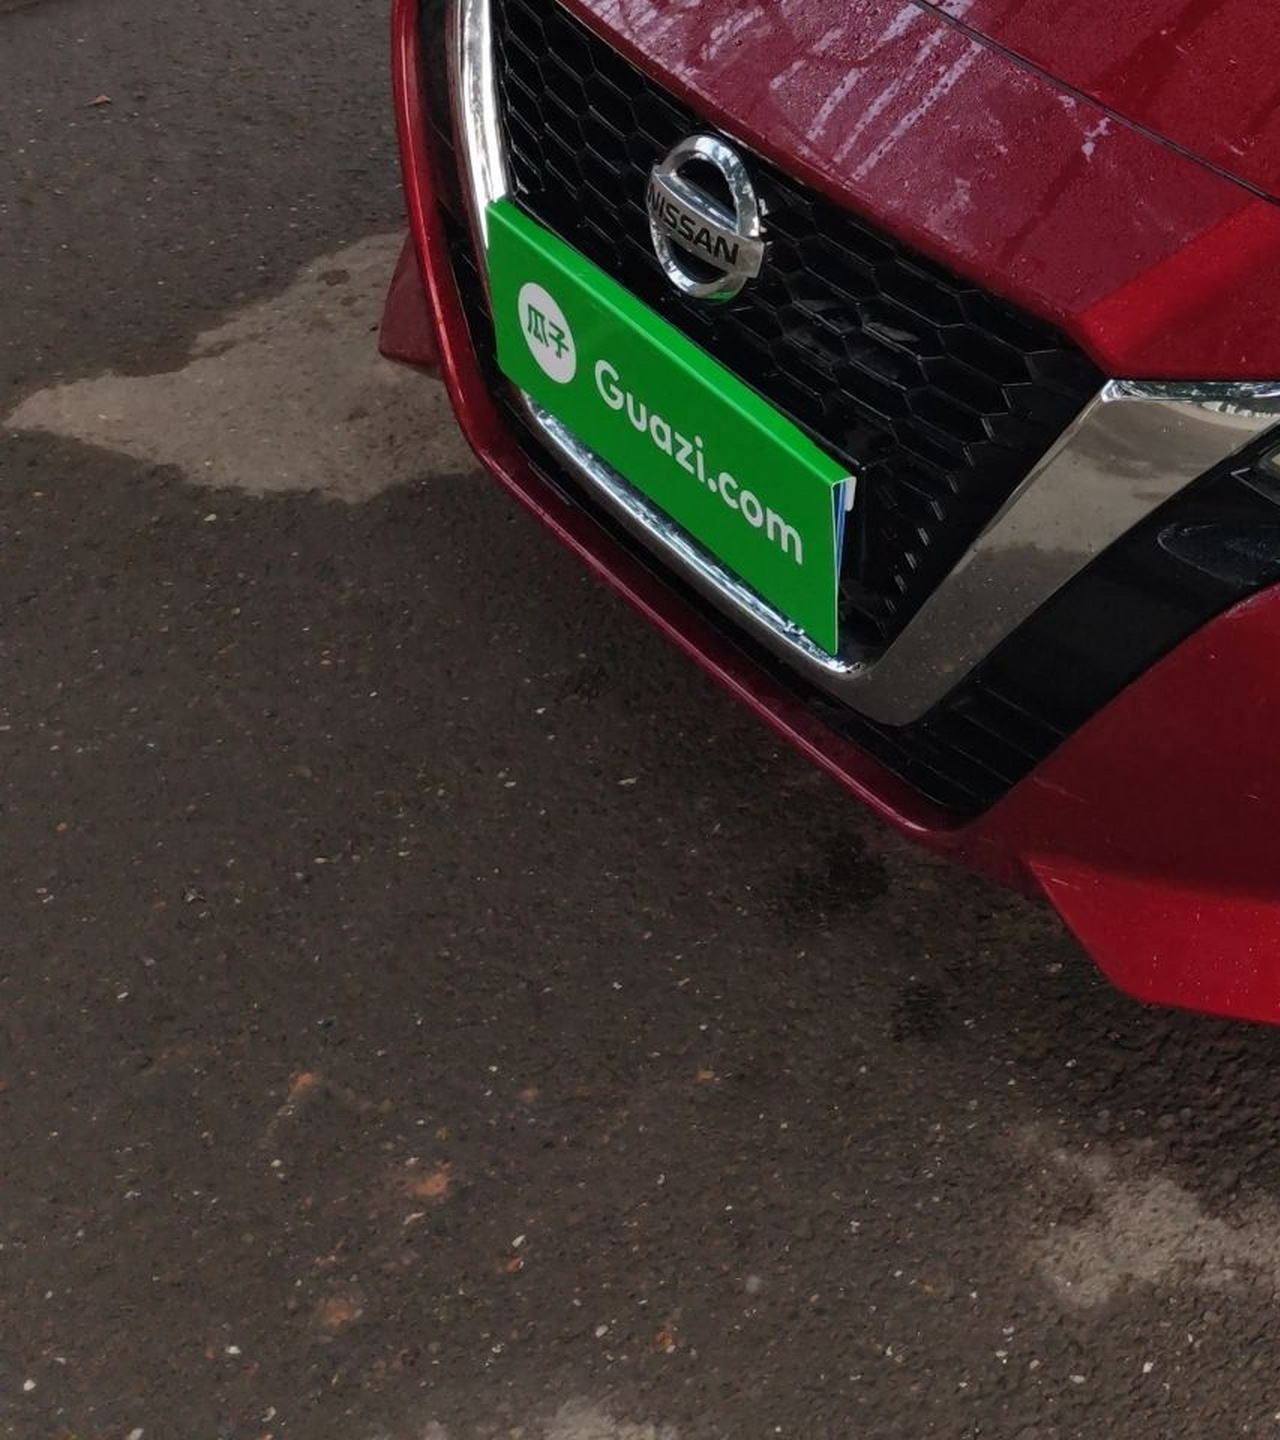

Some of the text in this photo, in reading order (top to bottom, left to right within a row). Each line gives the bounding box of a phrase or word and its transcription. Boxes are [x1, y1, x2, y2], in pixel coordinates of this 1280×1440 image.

[648, 182, 740, 265] NISSAN
[527, 303, 570, 359] 瓜子
[594, 359, 803, 565] Guazi.com
